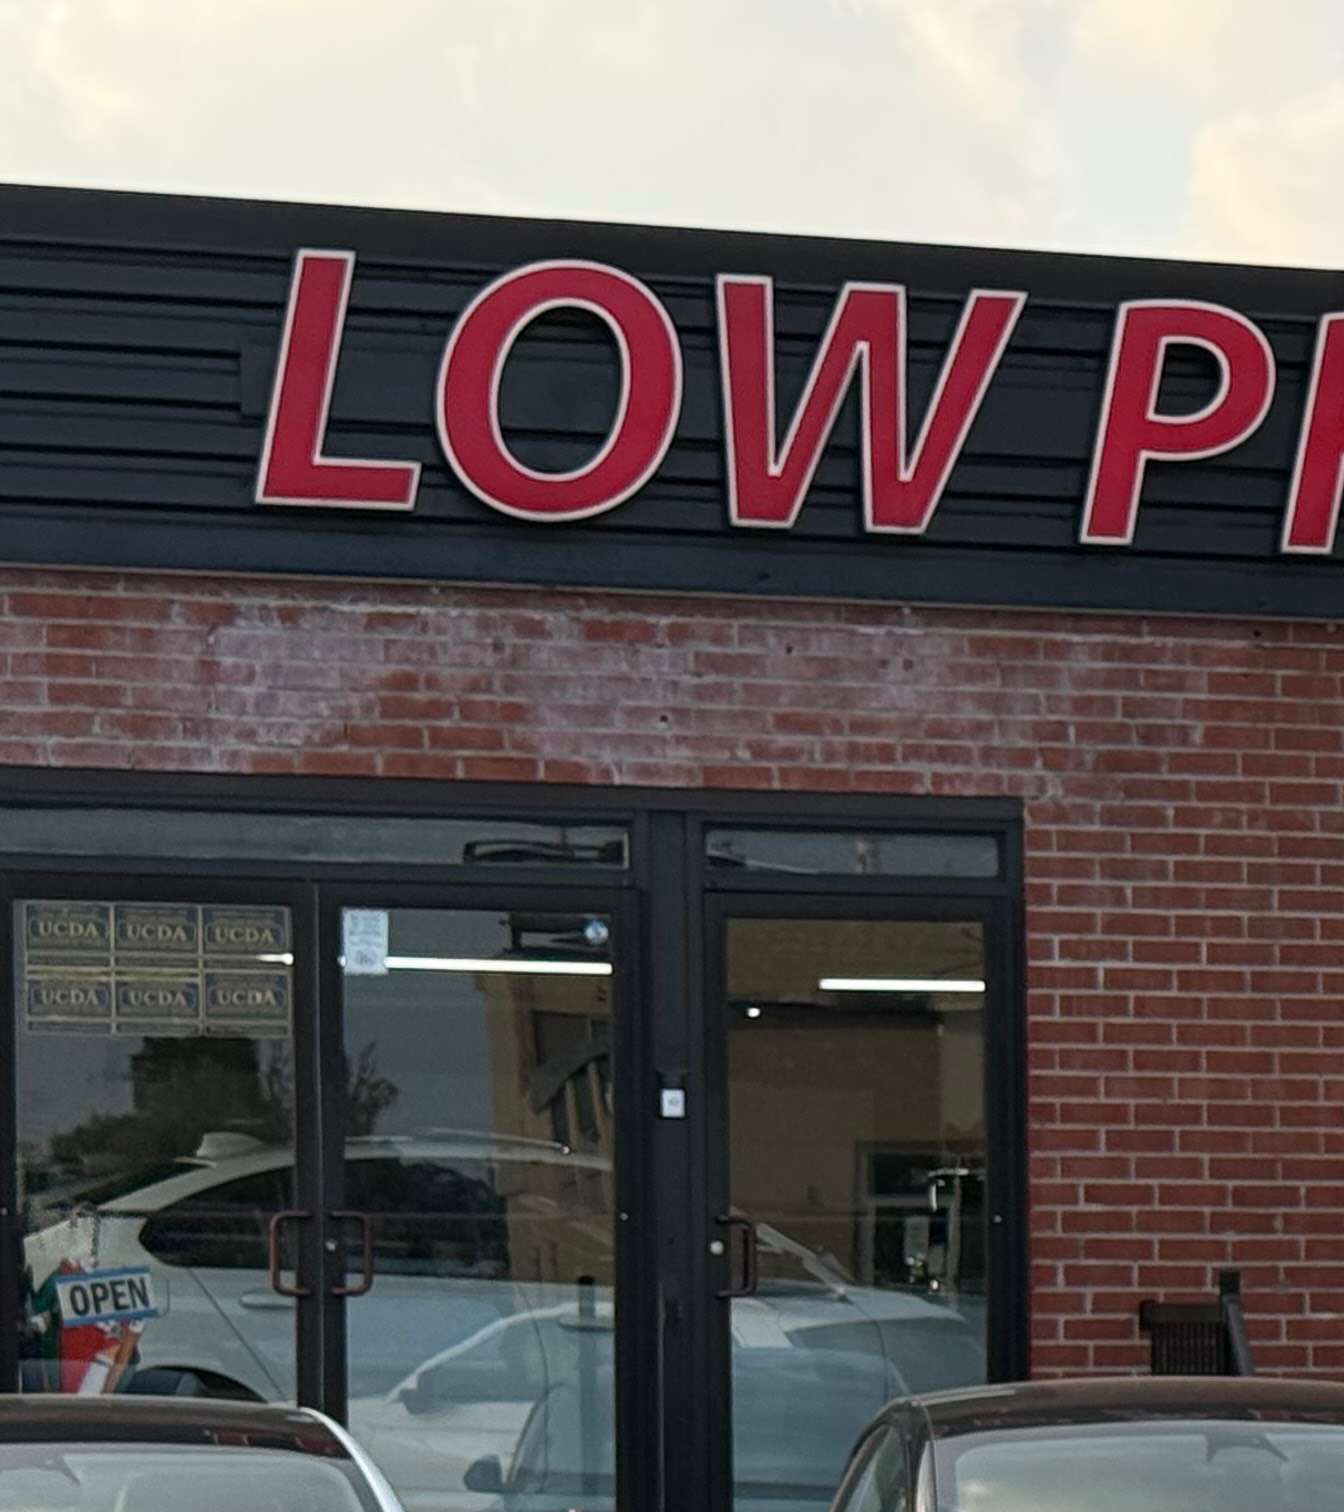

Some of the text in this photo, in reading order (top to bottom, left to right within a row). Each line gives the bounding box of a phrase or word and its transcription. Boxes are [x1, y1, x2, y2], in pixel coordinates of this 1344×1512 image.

[255, 249, 1028, 533] LOW
[38, 920, 99, 938] UCDA
[127, 923, 187, 942] UCDA
[215, 927, 275, 944] UCDA
[41, 989, 99, 1006] UCDA
[130, 991, 187, 1007] UCDA
[217, 990, 277, 1006] UCDA
[69, 1276, 150, 1316] OPEN
